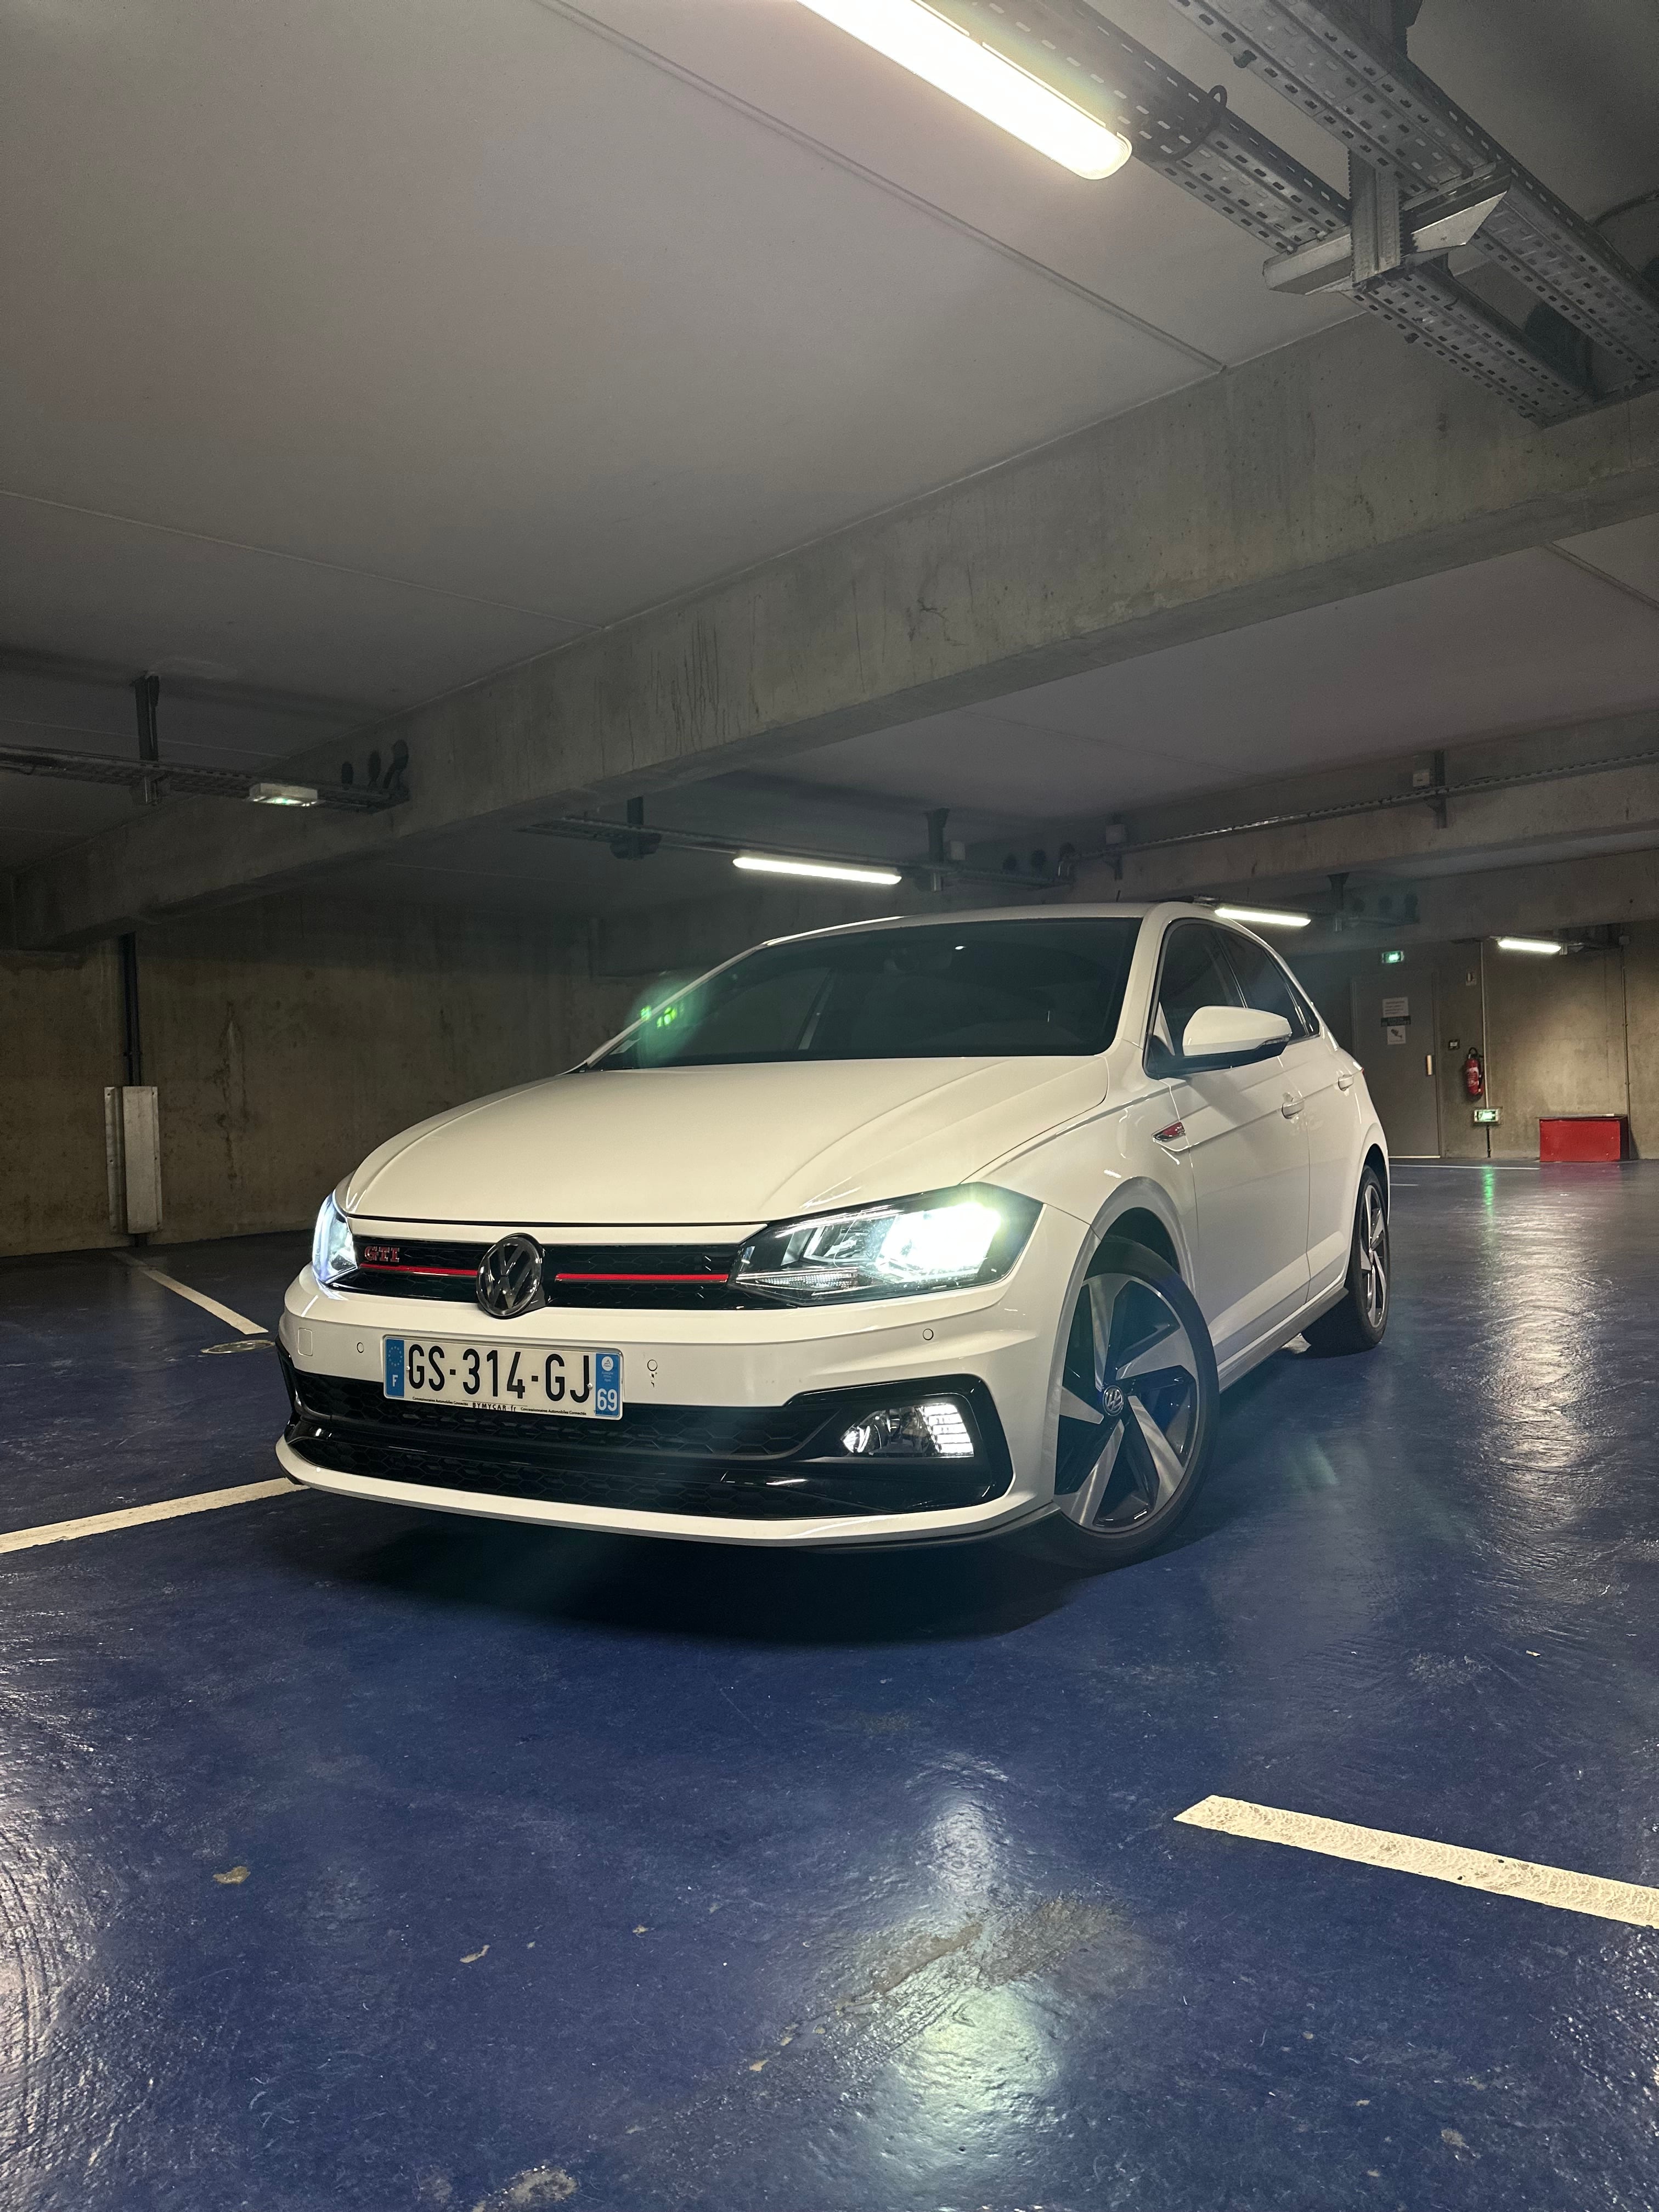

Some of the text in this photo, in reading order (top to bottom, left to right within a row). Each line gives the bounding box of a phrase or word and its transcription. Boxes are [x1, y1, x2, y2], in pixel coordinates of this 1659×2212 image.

[364, 1246, 399, 1262] GTI
[392, 1374, 398, 1387] F
[408, 1344, 590, 1403] GS-314-GJ
[597, 1388, 617, 1412] 69
